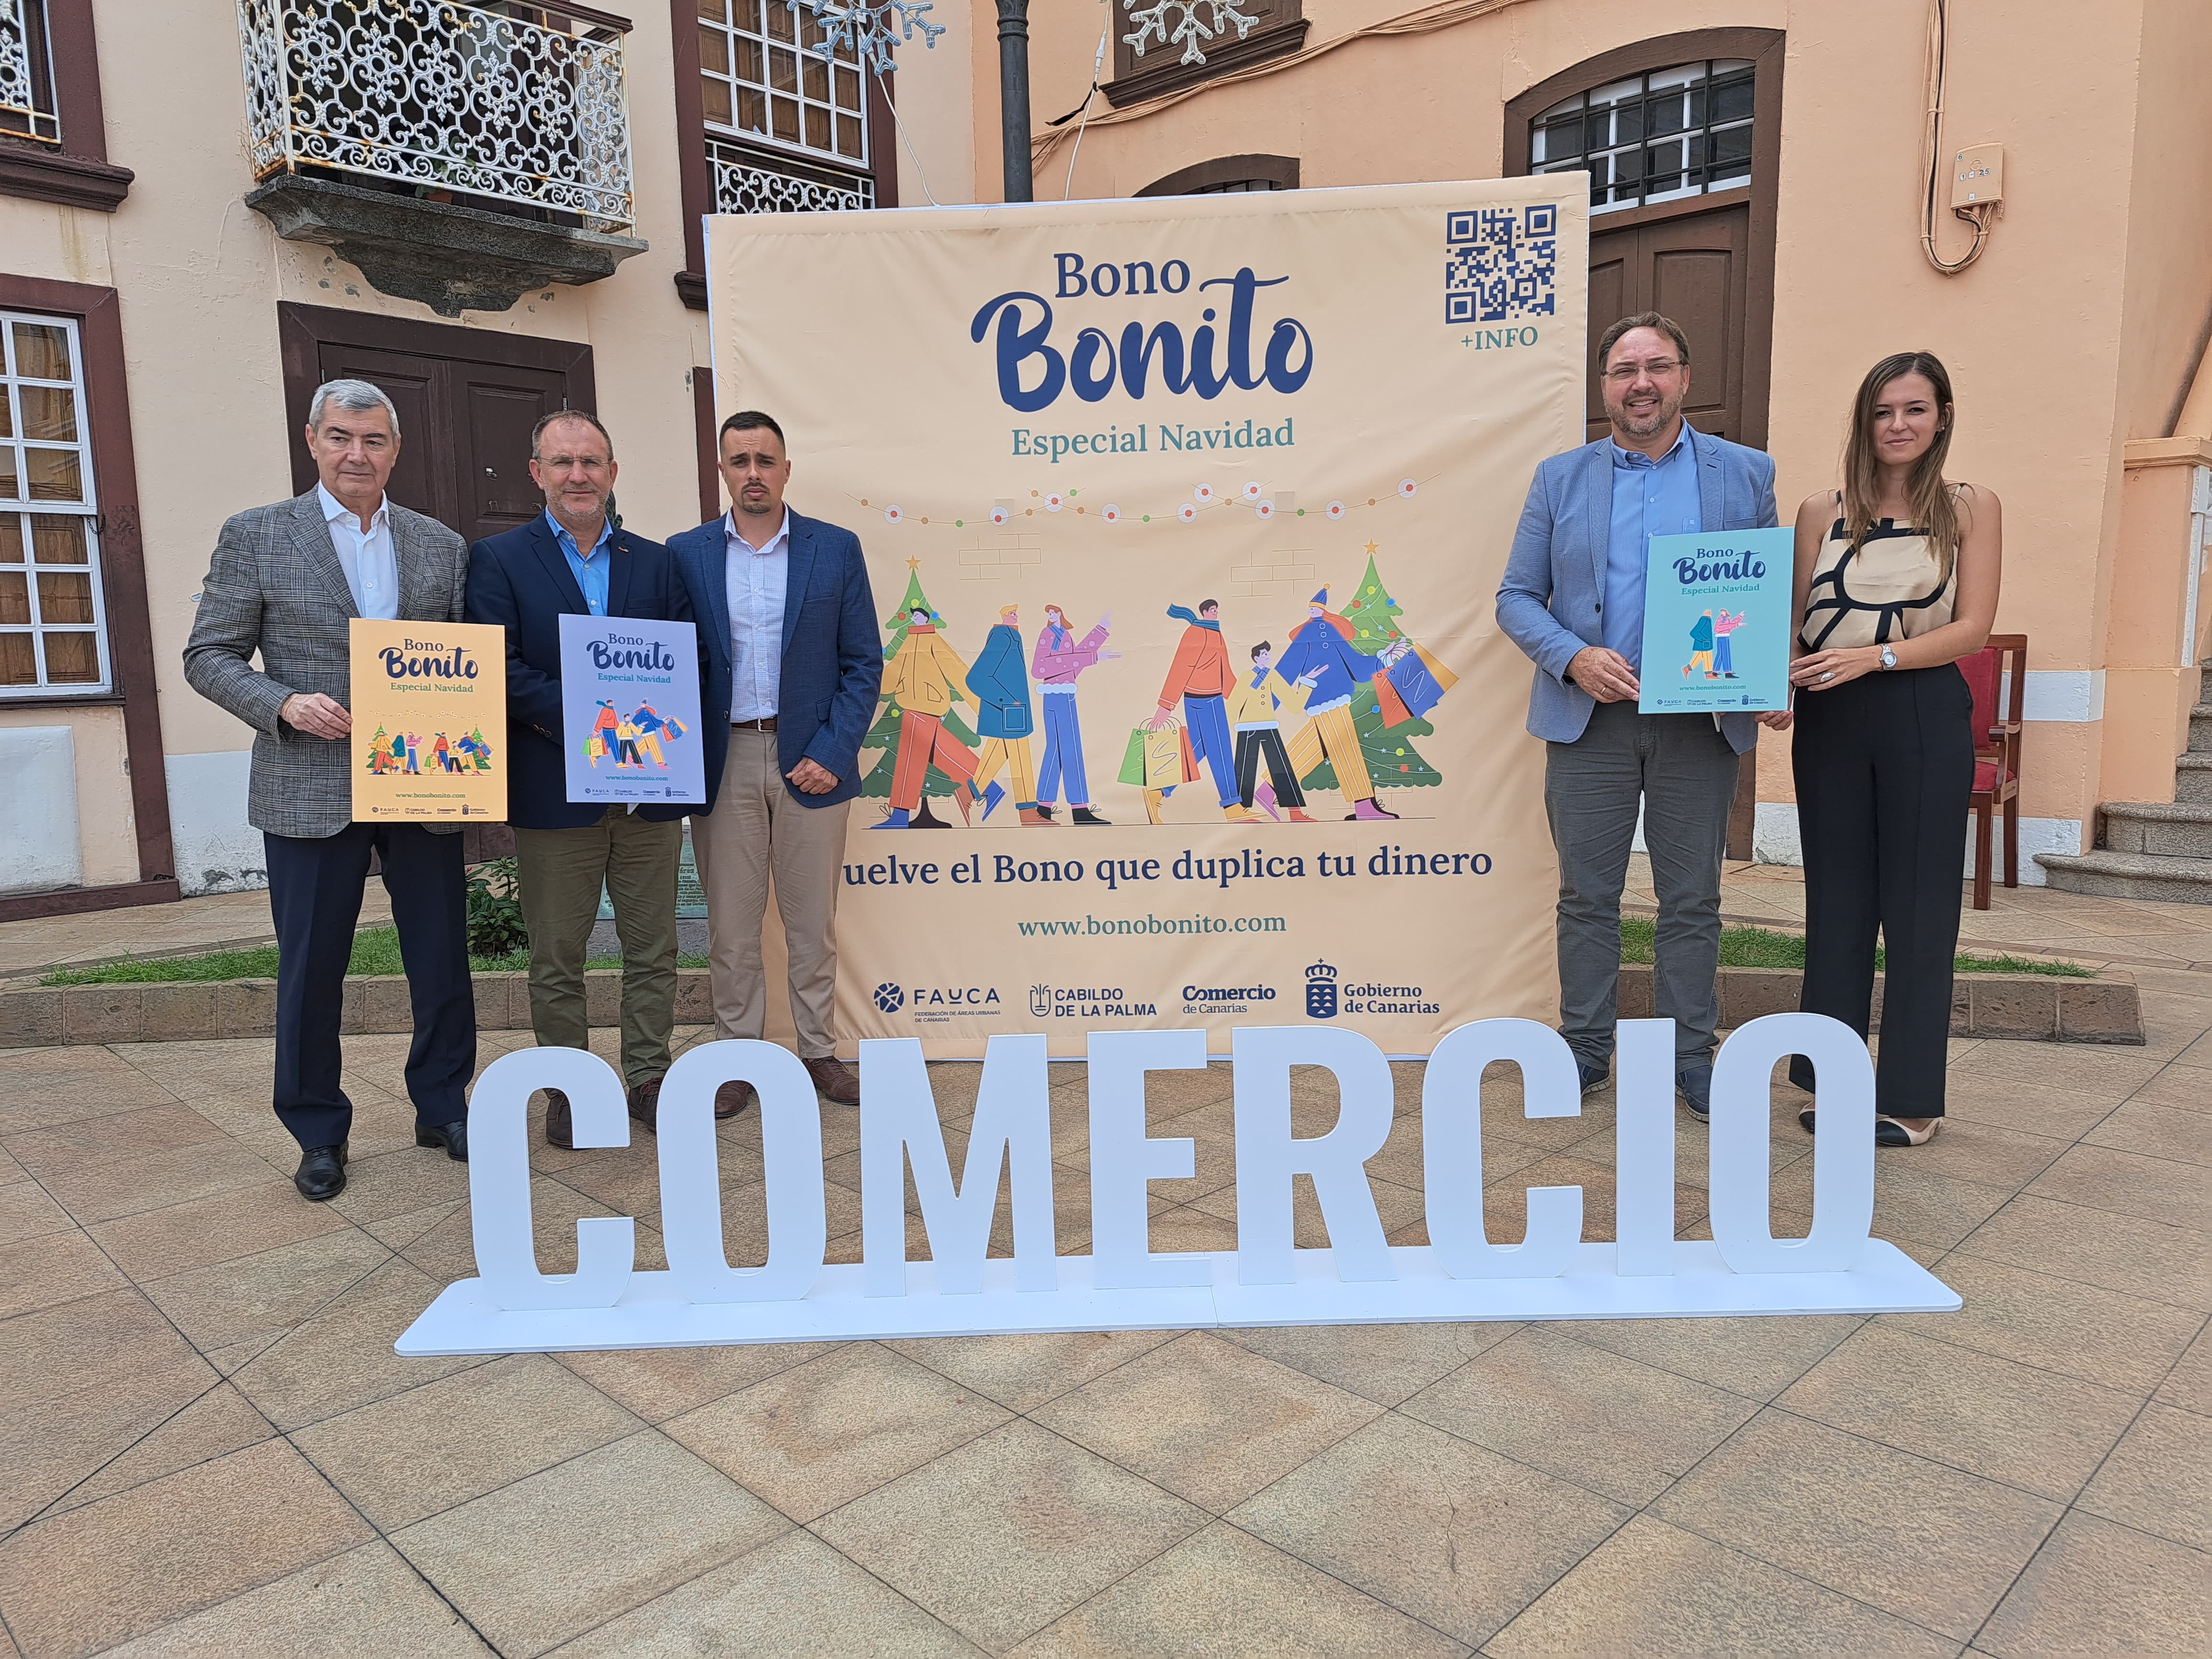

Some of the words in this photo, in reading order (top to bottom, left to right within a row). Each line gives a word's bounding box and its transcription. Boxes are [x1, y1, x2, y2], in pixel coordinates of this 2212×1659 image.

[1054, 253, 1190, 298] Bono
[971, 267, 1313, 413] Bonito
[1460, 326, 1538, 350] +INFO
[1012, 424, 1148, 463] Especial
[1160, 418, 1294, 452] Navidad
[1696, 549, 1733, 558] Bono
[1673, 551, 1766, 585] Bonito
[1681, 586, 1719, 596] Especial
[1722, 584, 1759, 593] Navidad
[404, 639, 443, 651] Bono
[608, 633, 643, 645] Bono
[378, 647, 478, 679] Bonito
[586, 641, 674, 671] Bonito
[598, 673, 634, 682] Especial
[637, 675, 671, 683] Navidad
[390, 682, 431, 693] Especial
[434, 683, 474, 692] Navidad
[843, 855, 939, 885] uelve
[951, 854, 982, 884] el
[993, 855, 1084, 883] Bono
[1095, 859, 1160, 889] que
[1172, 849, 1306, 888] duplica
[1317, 852, 1356, 877] tu
[1368, 845, 1492, 876] dinero
[1018, 914, 1286, 936] www.bonobonito.com
[914, 988, 1000, 1005] FAUCA
[1055, 988, 1123, 1001] CABILDO
[1183, 984, 1276, 1001] Comercio
[1344, 984, 1422, 997] Gobierno
[1055, 1005, 1075, 1017] DE
[1081, 1005, 1101, 1016] LA
[1106, 1004, 1157, 1016] PALMA
[1183, 1004, 1197, 1014] de
[1199, 1003, 1247, 1013] Canarias
[1345, 999, 1363, 1013] de
[1367, 1000, 1439, 1013] Canarias
[467, 1012, 1876, 1310] COMERCIO
